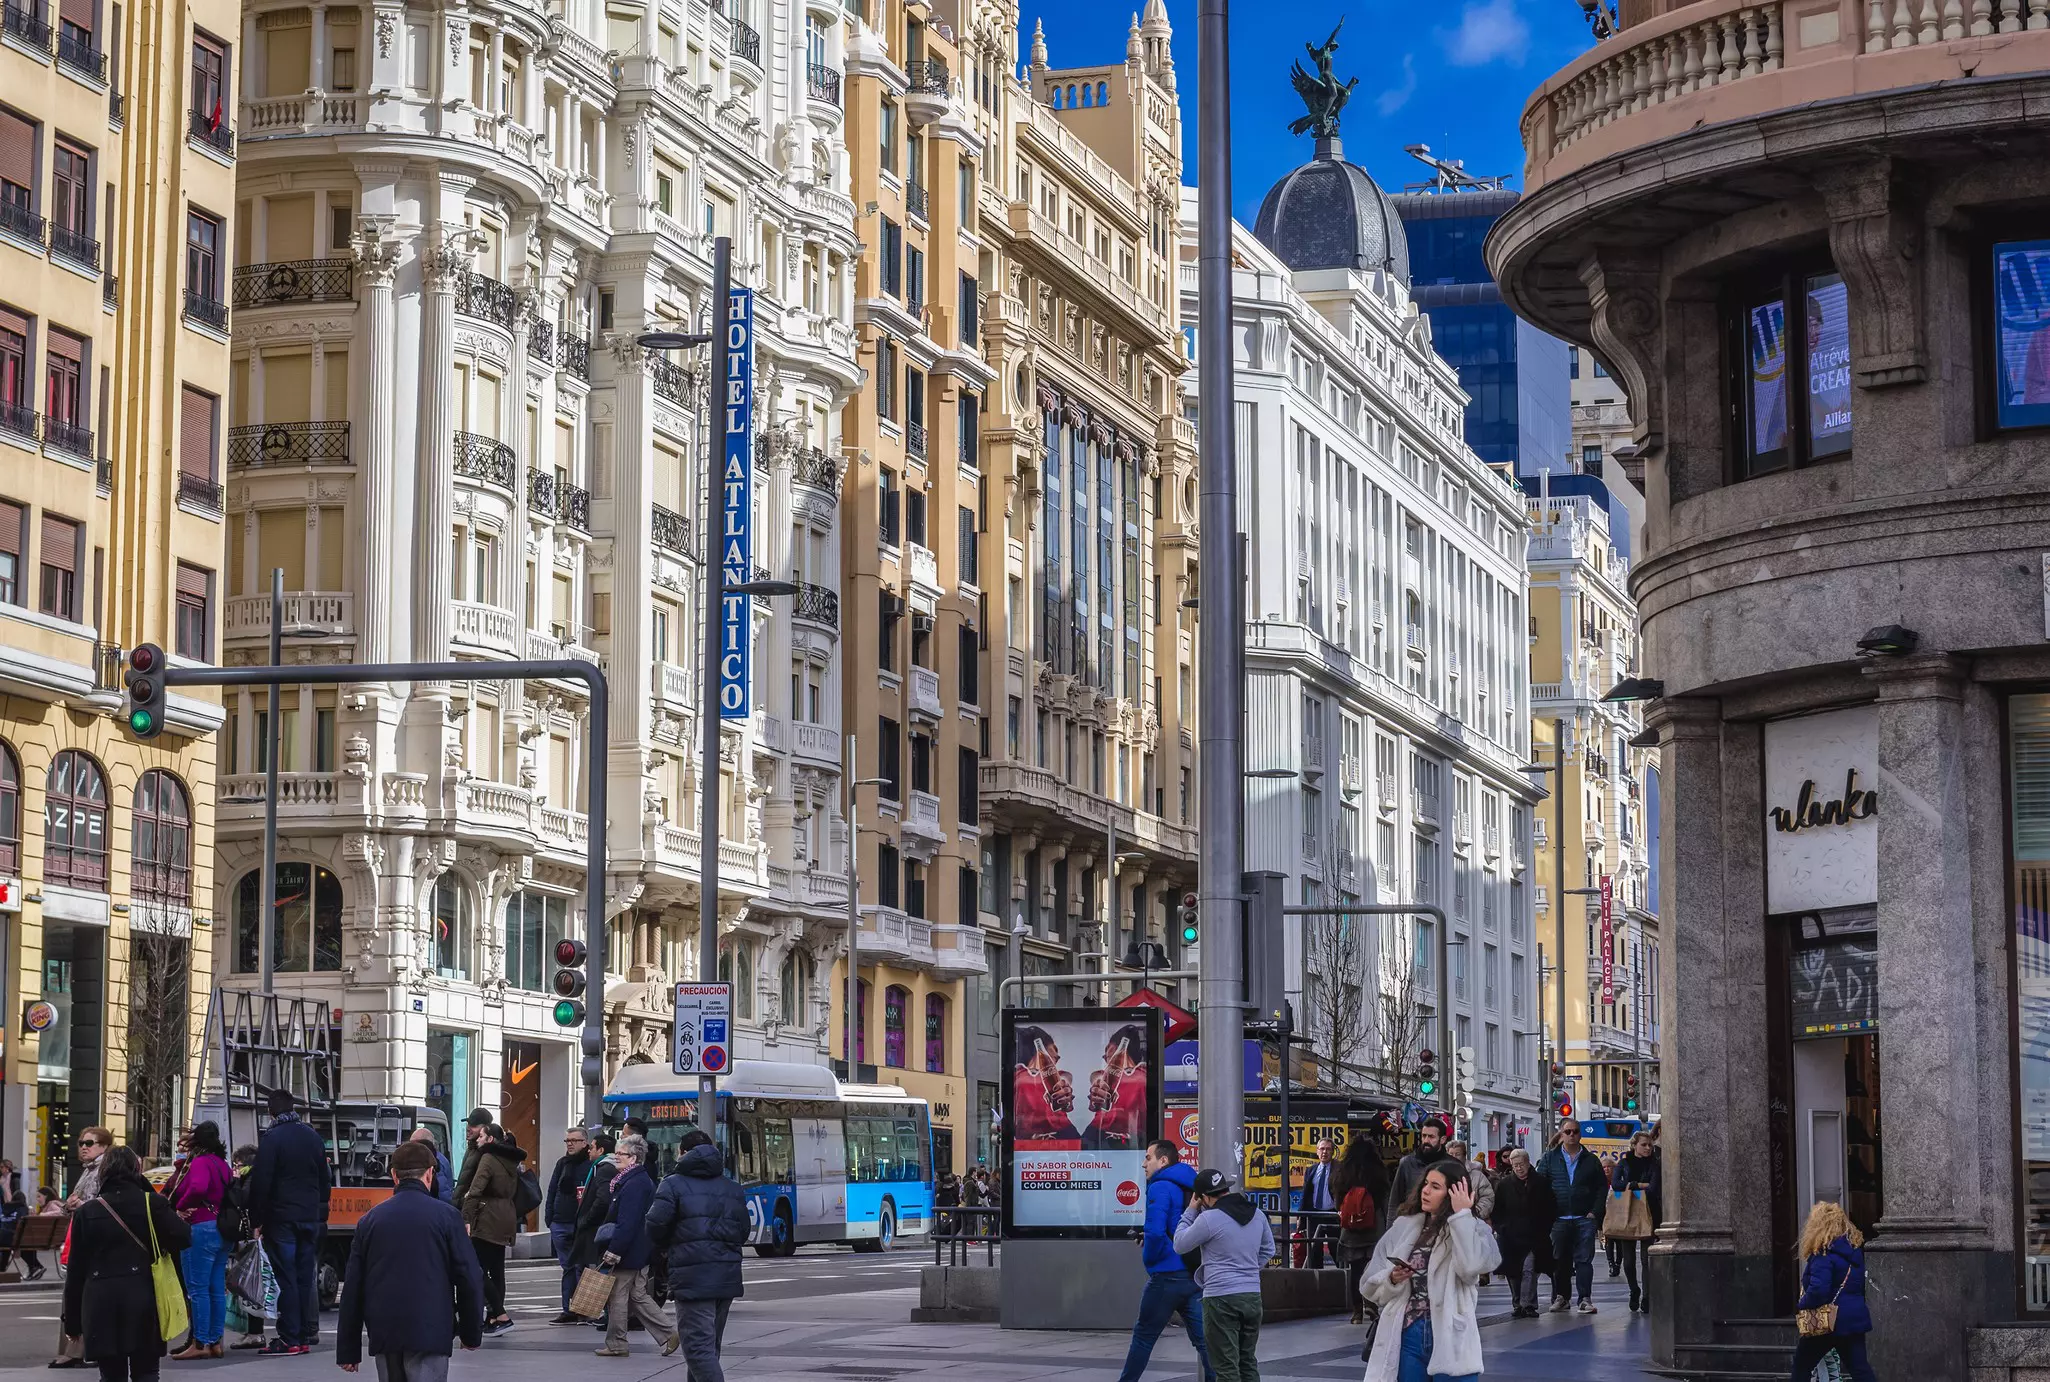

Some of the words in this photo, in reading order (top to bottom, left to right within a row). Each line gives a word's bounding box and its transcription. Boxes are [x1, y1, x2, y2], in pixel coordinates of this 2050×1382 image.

[728, 295, 747, 433] HOTEL
[721, 453, 746, 710] ATLANTICO
[680, 986, 727, 995] PRECAUCIÓN
[682, 1054, 691, 1066] 30
[624, 1106, 629, 1120] 1
[651, 1105, 678, 1118] CRISTO
[1310, 1126, 1345, 1145] BUS
[1024, 1172, 1035, 1180] LO
